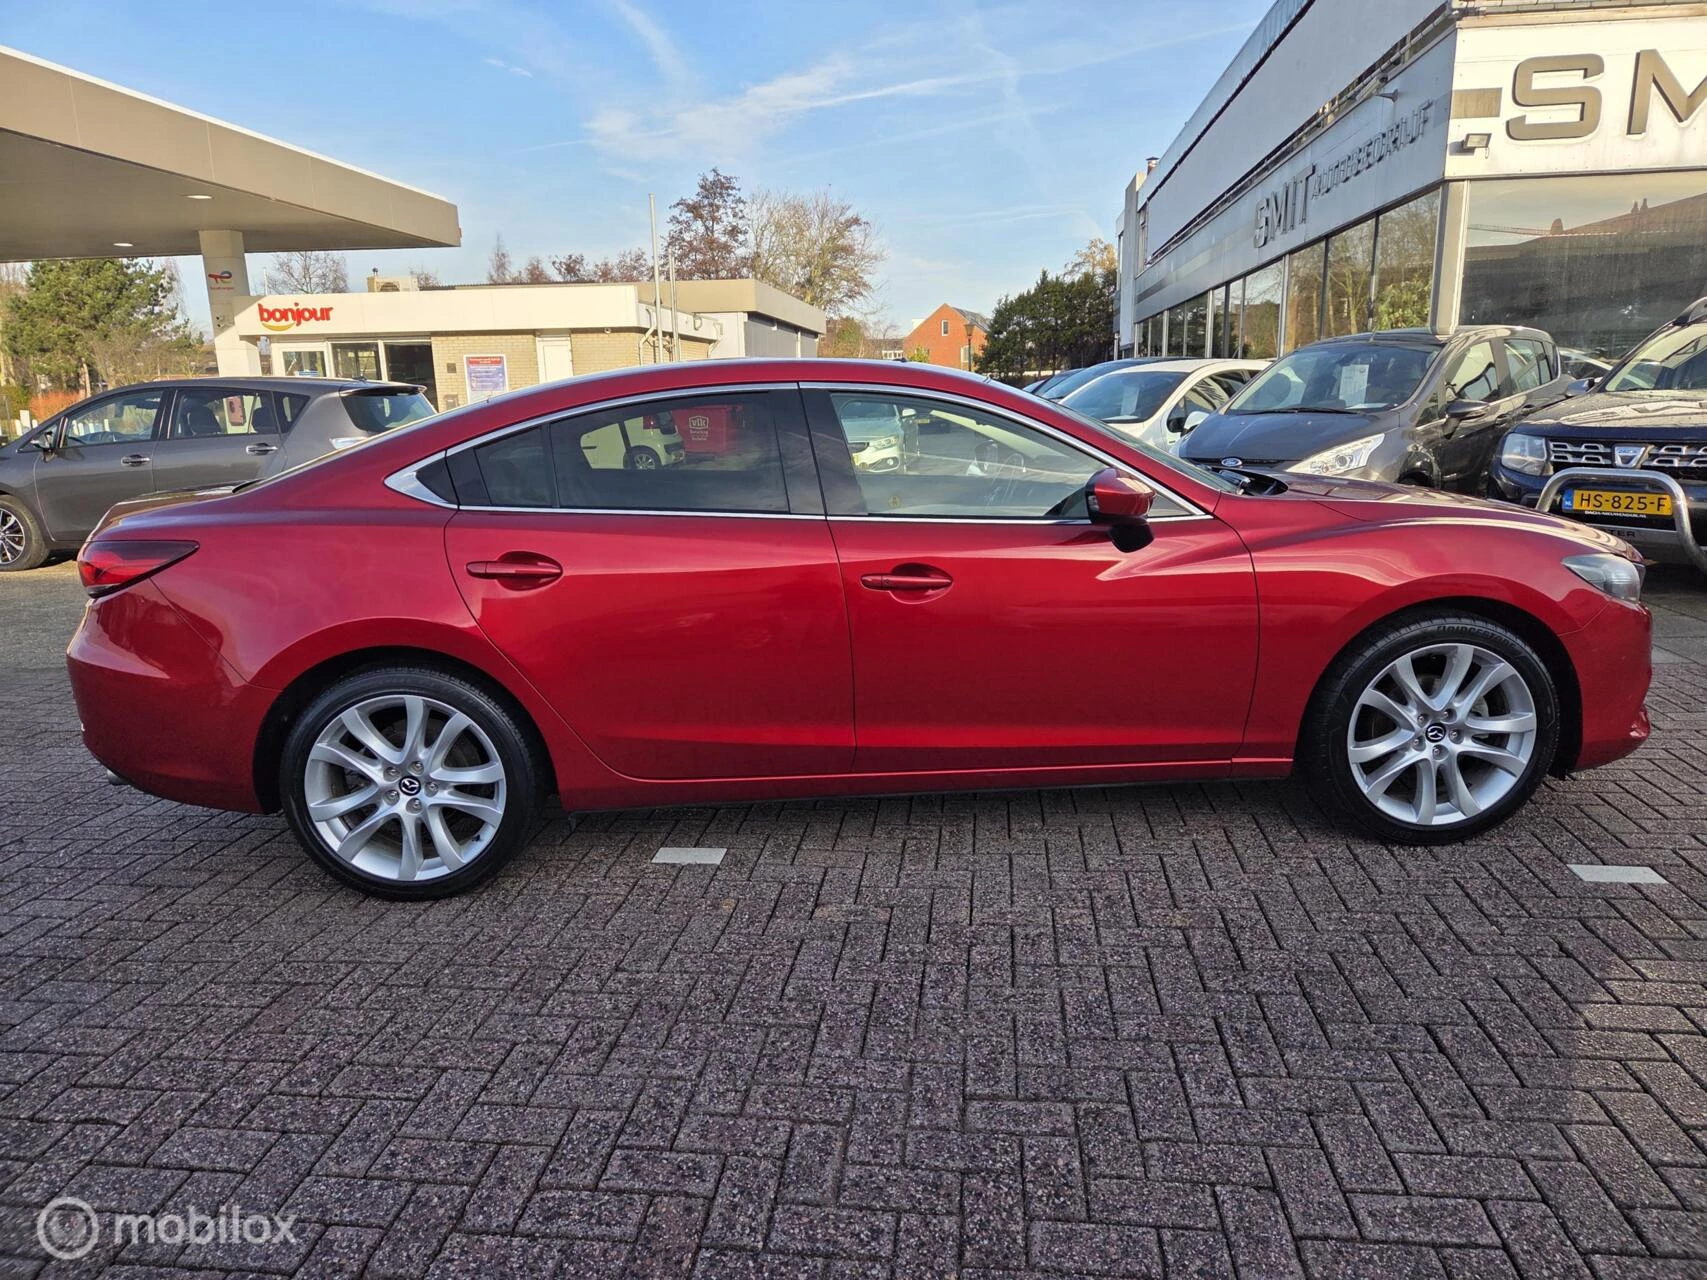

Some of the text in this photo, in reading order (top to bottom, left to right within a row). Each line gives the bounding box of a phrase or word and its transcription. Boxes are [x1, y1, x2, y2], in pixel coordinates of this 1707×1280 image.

[1254, 100, 1433, 248] SMIT AUTOBEDRIJF
[258, 302, 333, 326] bonjour
[1580, 493, 1667, 511] HS-825-F
